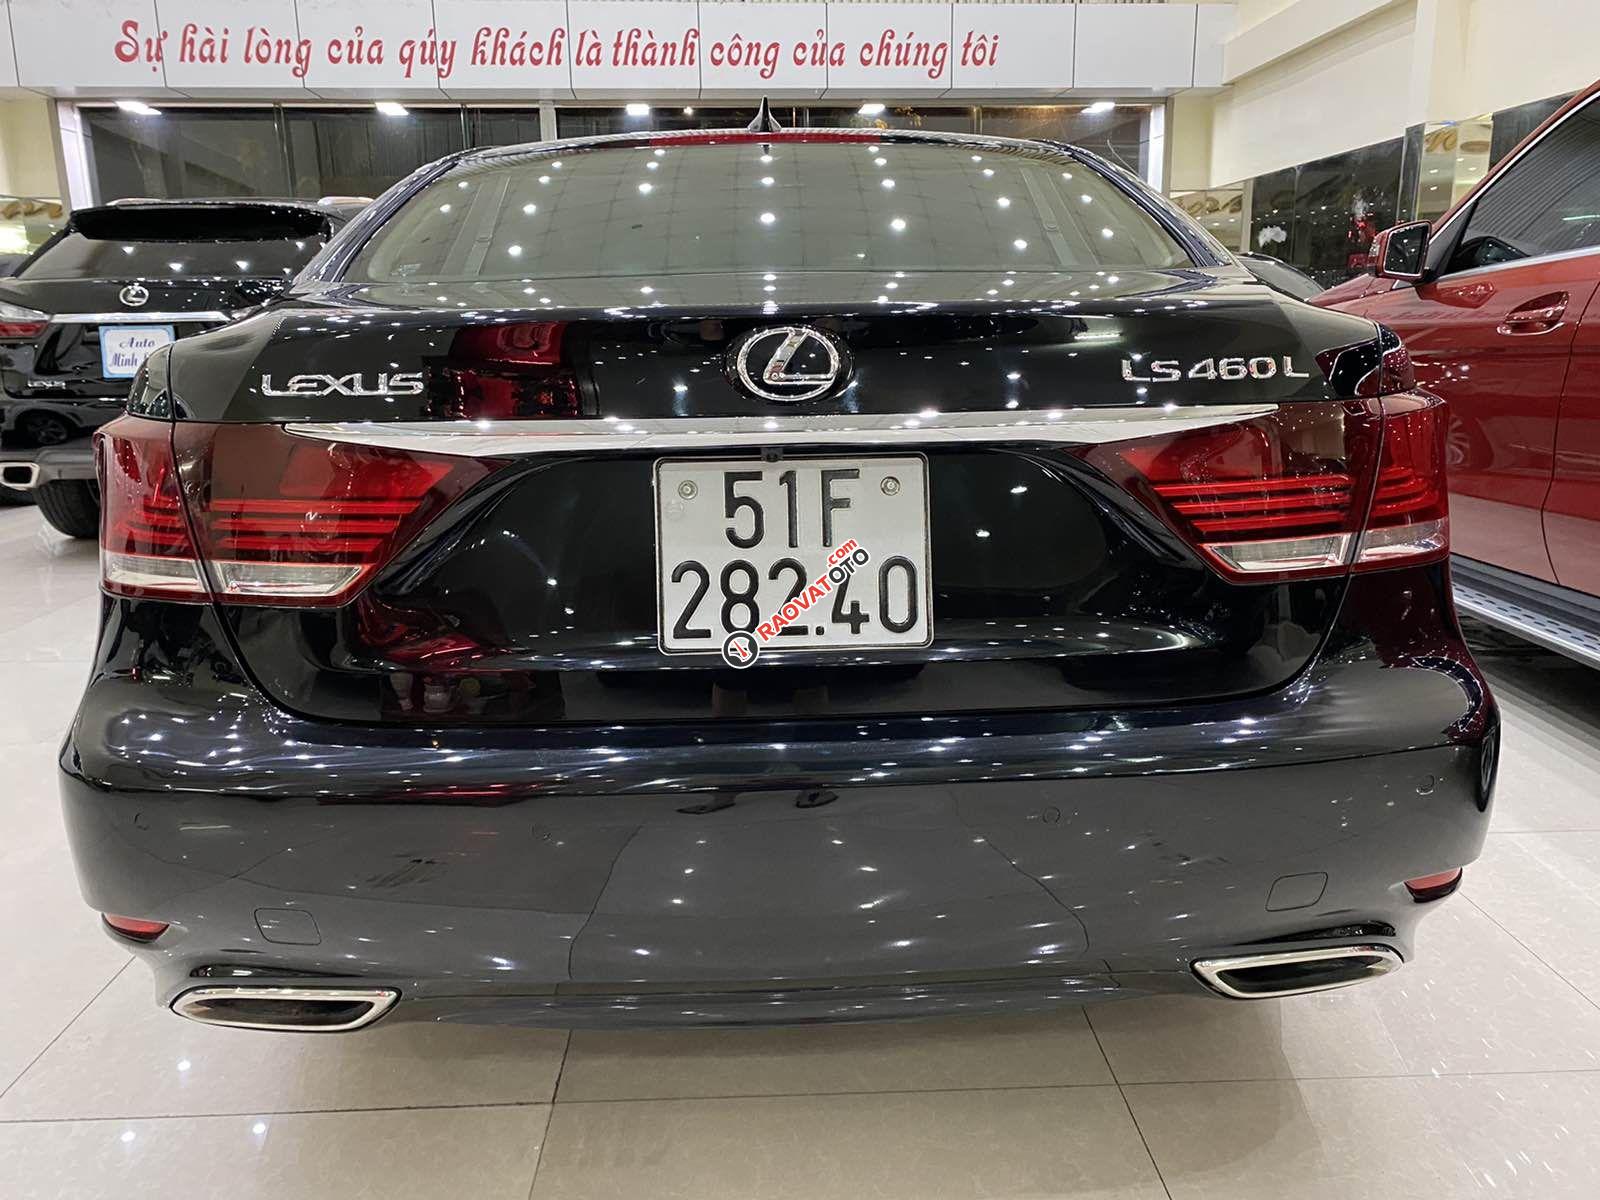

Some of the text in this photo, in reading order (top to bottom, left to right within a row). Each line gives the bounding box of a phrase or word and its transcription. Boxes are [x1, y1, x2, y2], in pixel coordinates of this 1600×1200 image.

[114, 20, 168, 72] Sự
[179, 23, 229, 63] hài
[243, 26, 312, 78] lòng
[327, 26, 383, 64] của
[471, 26, 565, 66] khách
[575, 28, 602, 66] là
[612, 27, 699, 66] thành
[710, 32, 780, 79] công
[792, 28, 846, 66] của
[859, 28, 949, 79] chúng
[960, 30, 1000, 66] tôi
[261, 372, 424, 396] LEXUS
[723, 468, 860, 549] 51F
[671, 555, 919, 640] 282.40
